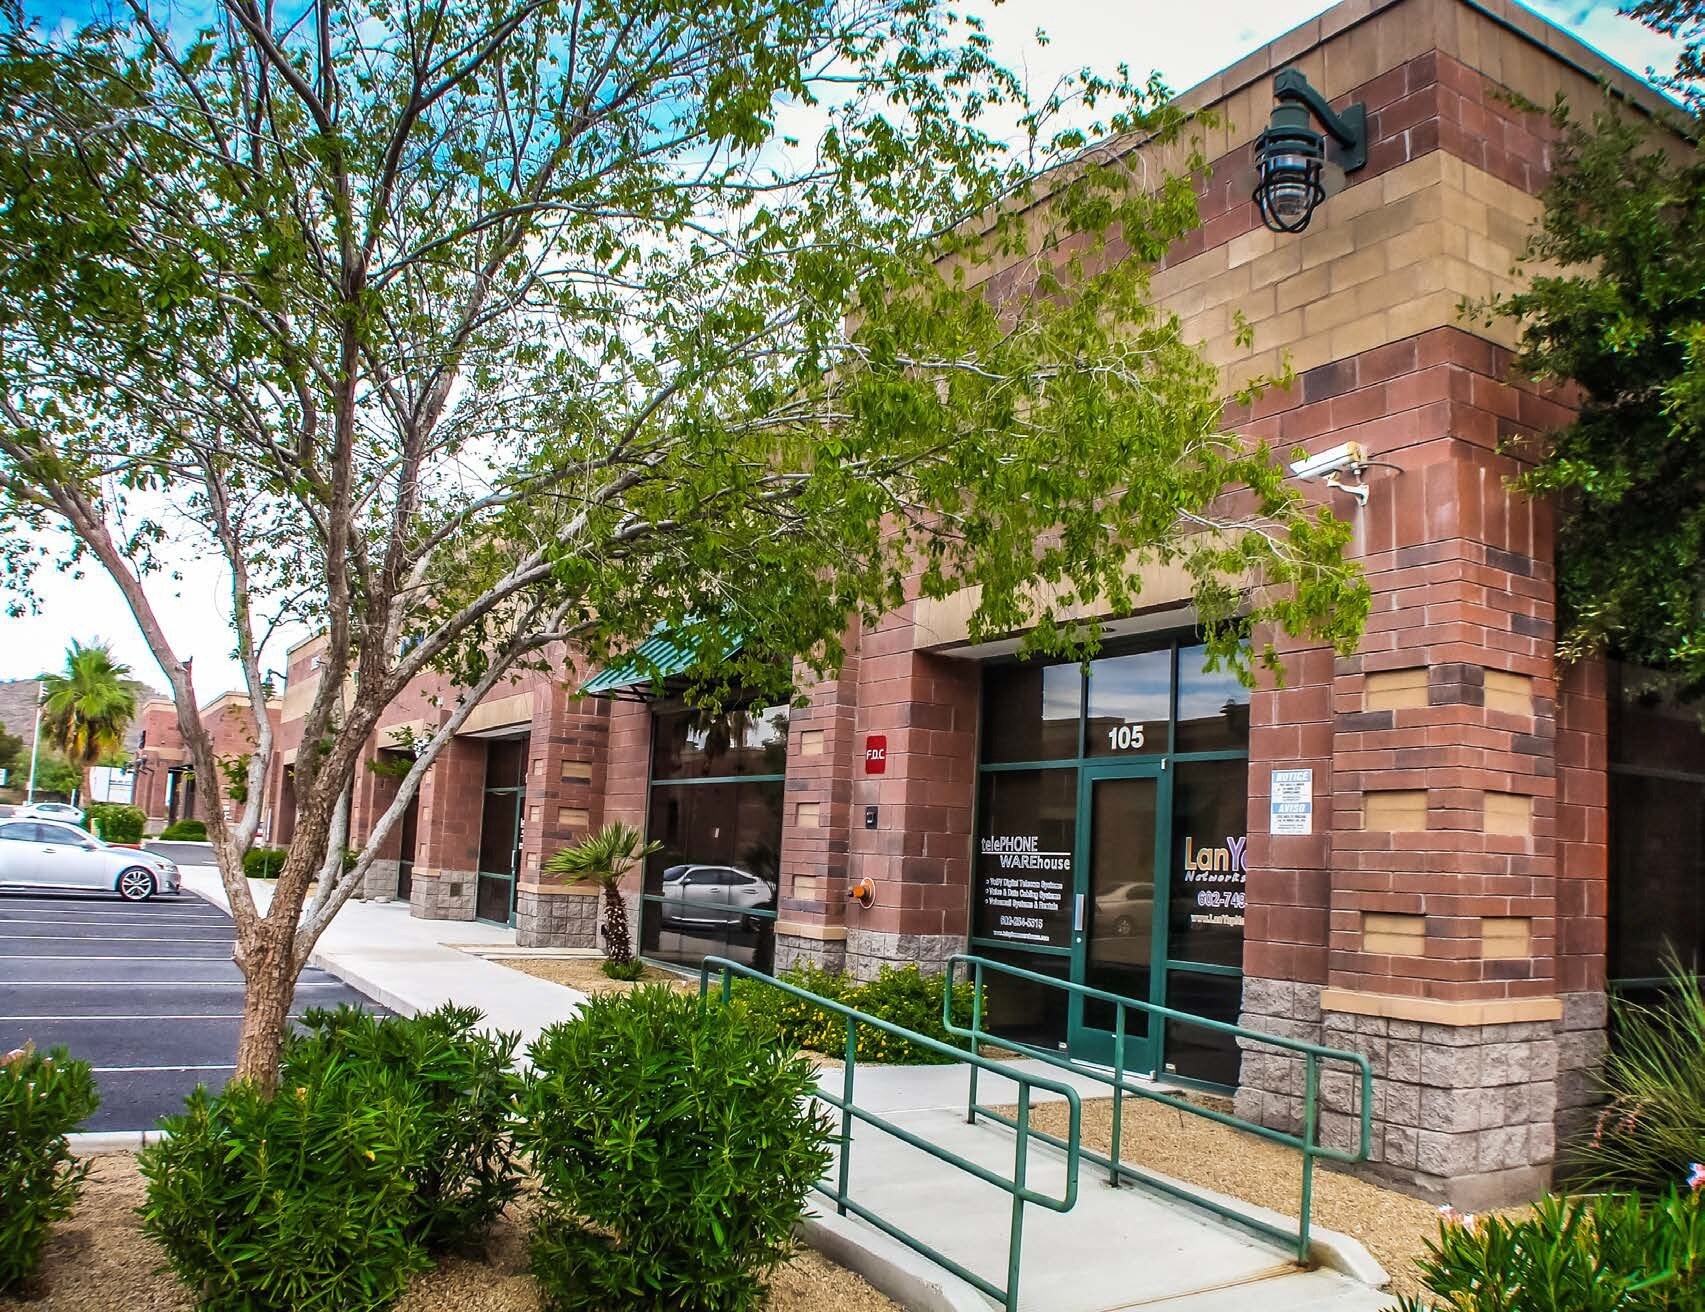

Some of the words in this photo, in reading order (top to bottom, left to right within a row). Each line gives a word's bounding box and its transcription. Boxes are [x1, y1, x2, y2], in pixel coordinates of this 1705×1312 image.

[1109, 725, 1144, 750] 105
[1276, 771, 1310, 782] NOTICE
[1278, 803, 1306, 813] AVISO
[981, 836, 1038, 852] telePHONE
[999, 855, 1071, 871] WAREhouse
[1184, 871, 1246, 883] Networks
[1041, 881, 1063, 891] Systems
[1039, 891, 1061, 901] Systems
